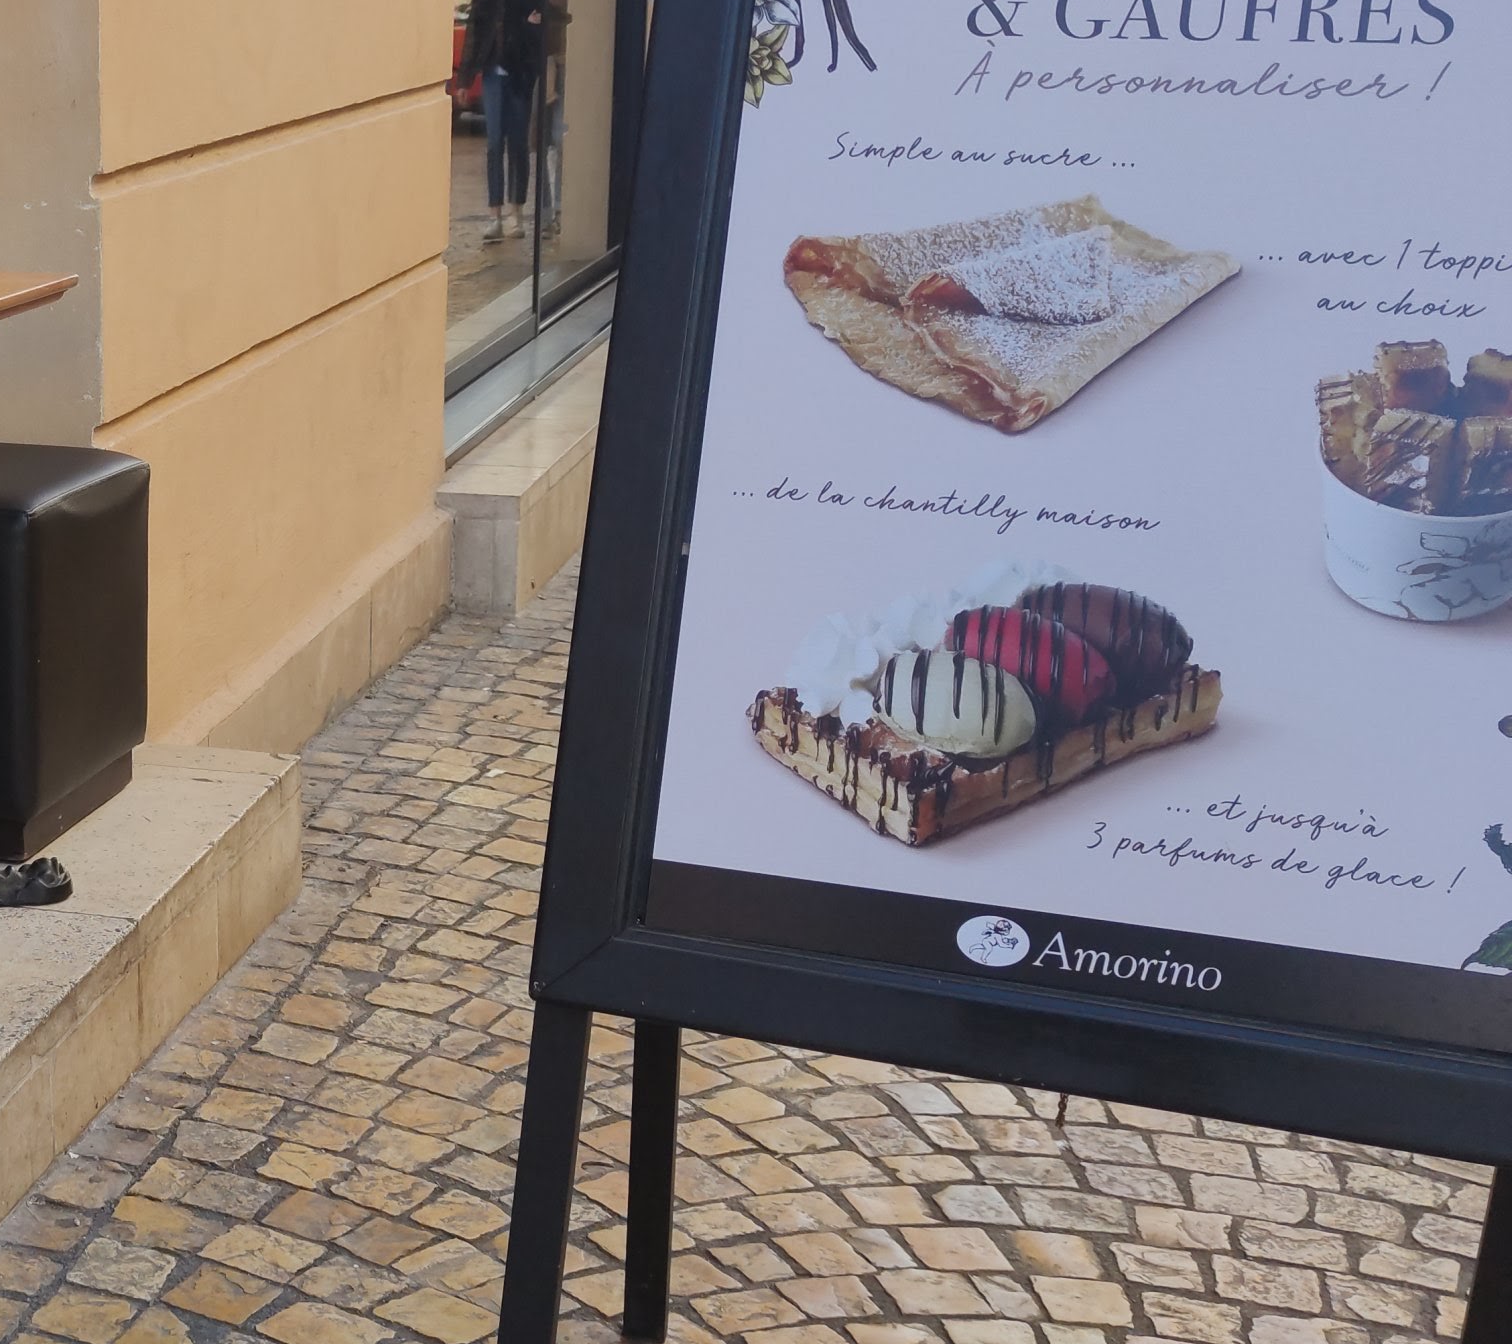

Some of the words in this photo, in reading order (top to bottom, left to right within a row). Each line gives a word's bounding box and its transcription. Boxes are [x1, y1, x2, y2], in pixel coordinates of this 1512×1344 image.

[954, 40, 995, 96] À
[1005, 62, 1409, 102] personnaliser
[828, 131, 943, 167] Simple
[951, 147, 996, 163] au
[1003, 148, 1102, 167] sucre
[1298, 250, 1386, 266] avec
[1419, 242, 1512, 279] toppi
[1316, 296, 1367, 311] au
[1376, 288, 1487, 318] choix
[766, 477, 809, 501] de
[817, 480, 855, 506] la
[863, 485, 1028, 534] chantilly
[1036, 506, 1160, 531] maison
[1206, 794, 1247, 821] et
[1245, 804, 1390, 840] jusqu'à
[1087, 821, 1107, 849] 3
[1112, 837, 1263, 867] parfums
[1271, 848, 1321, 874] de
[1327, 857, 1436, 890] glace
[1032, 931, 1222, 991] Amorino
